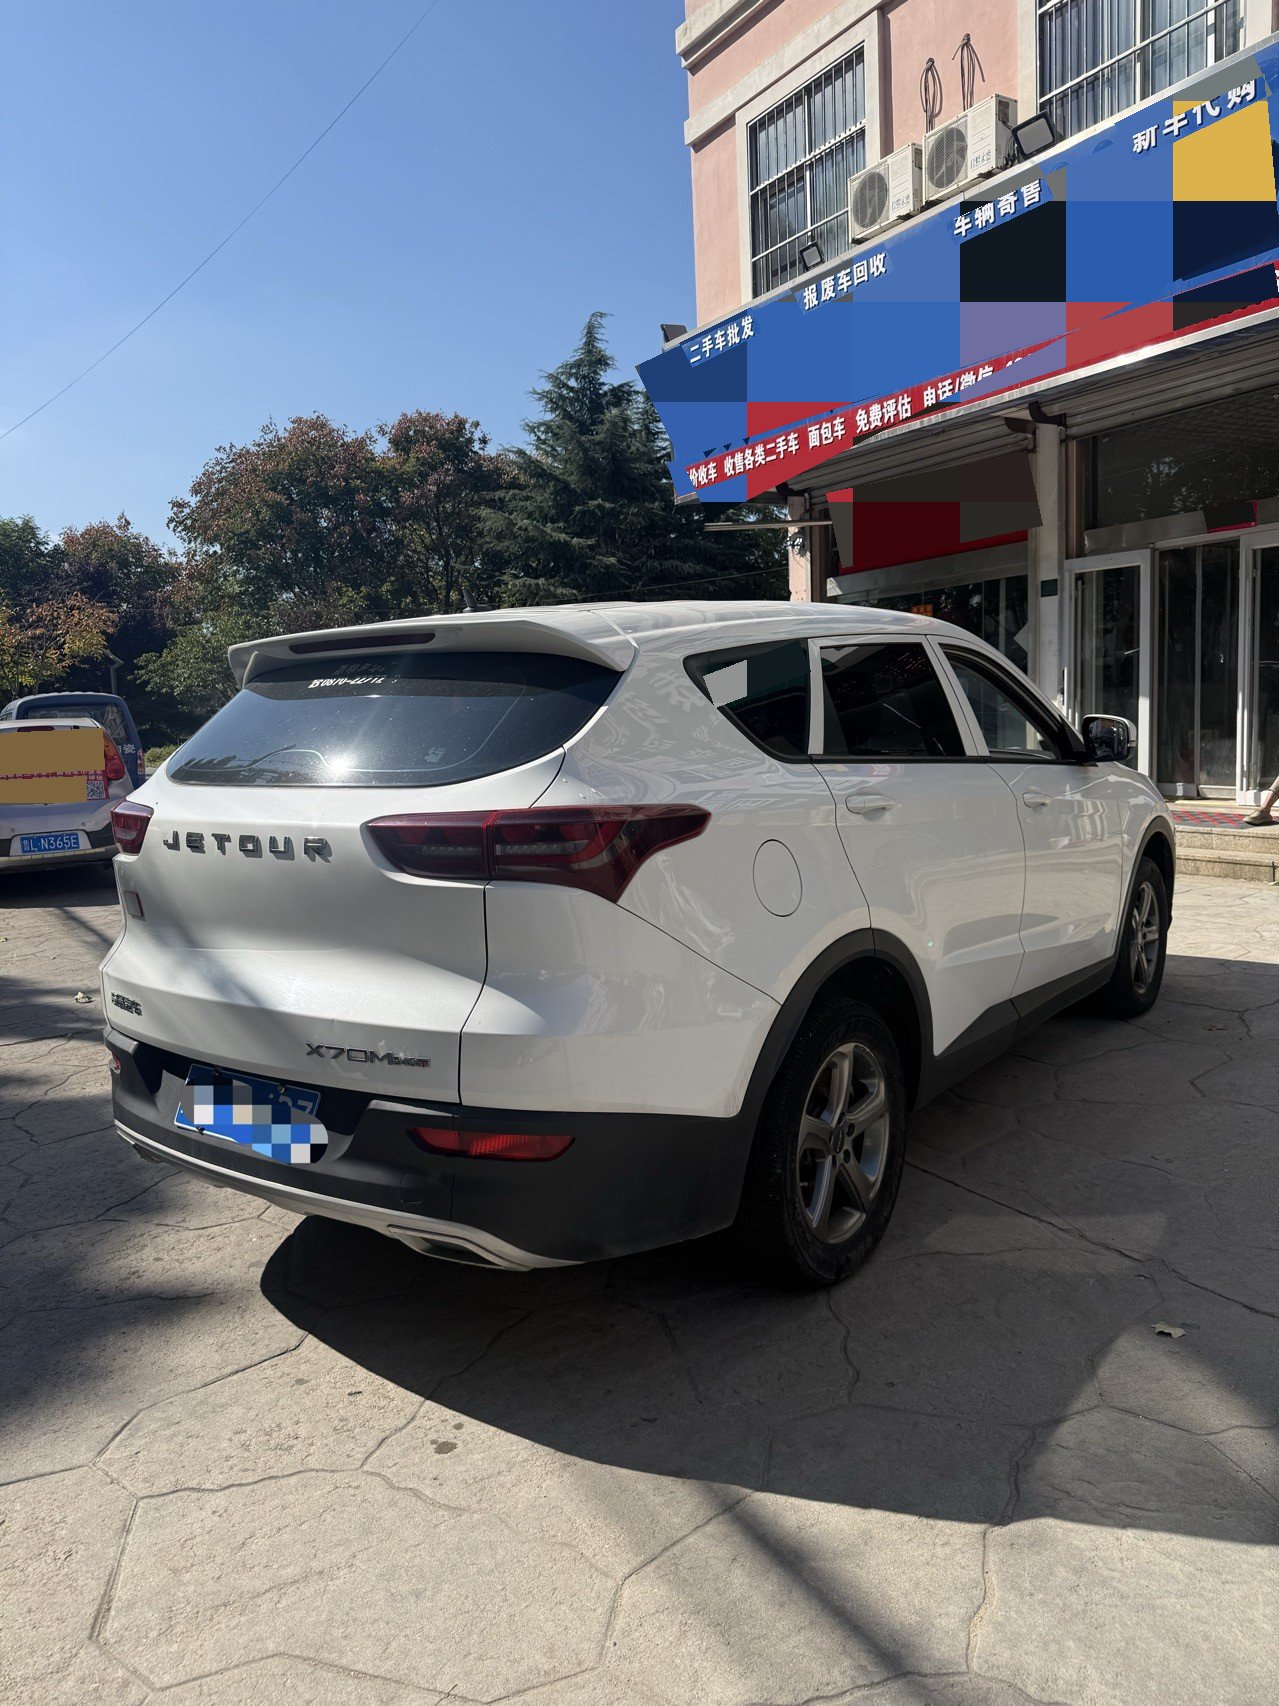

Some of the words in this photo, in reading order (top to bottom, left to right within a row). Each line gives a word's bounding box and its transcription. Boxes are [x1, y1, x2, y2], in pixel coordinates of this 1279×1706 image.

[690, 316, 755, 363] 二手车批发
[803, 252, 887, 311] 报废车回收
[687, 462, 718, 488] 价收车
[724, 432, 800, 477] 收售各类二手车
[808, 417, 846, 449] 面包车
[855, 394, 912, 433] 免费评估
[163, 830, 328, 862] JETOUR
[305, 1041, 393, 1065] X70M
